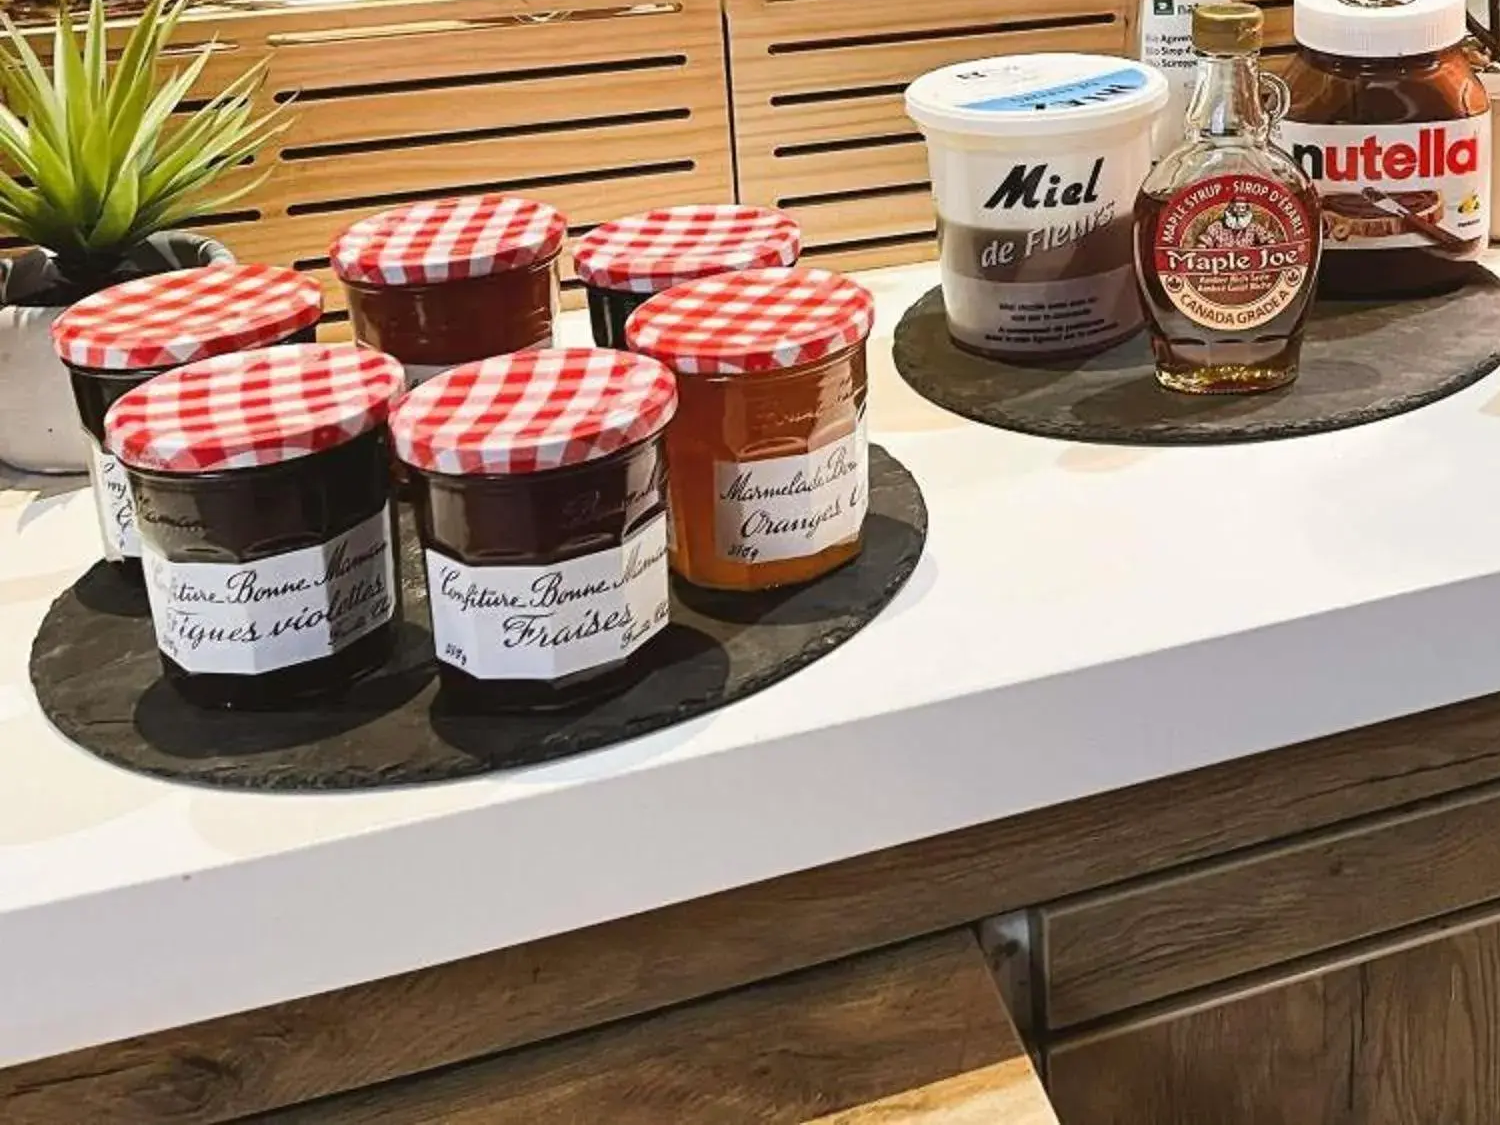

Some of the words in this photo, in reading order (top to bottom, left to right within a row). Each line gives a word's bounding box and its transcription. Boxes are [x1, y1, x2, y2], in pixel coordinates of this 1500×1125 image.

[1292, 127, 1478, 182] nutella
[983, 155, 1105, 210] Miel
[981, 239, 1015, 268] de
[1024, 200, 1116, 259] Fleurs
[1162, 204, 1187, 244] MAPLE
[1183, 182, 1223, 210] SYRUP
[1232, 179, 1269, 197] SIROP
[1166, 250, 1251, 276] Maple
[1258, 248, 1300, 269] Joe
[1178, 293, 1235, 325] CANADA
[1236, 297, 1282, 324] GRADE
[1279, 289, 1291, 303] A
[719, 467, 827, 503] Marmelade
[739, 494, 843, 540] Oranges
[225, 569, 310, 605] Bonne
[266, 573, 385, 638] violettes
[440, 565, 526, 612] Confiture
[528, 571, 610, 608] Bonne
[502, 602, 635, 649] Fraises
